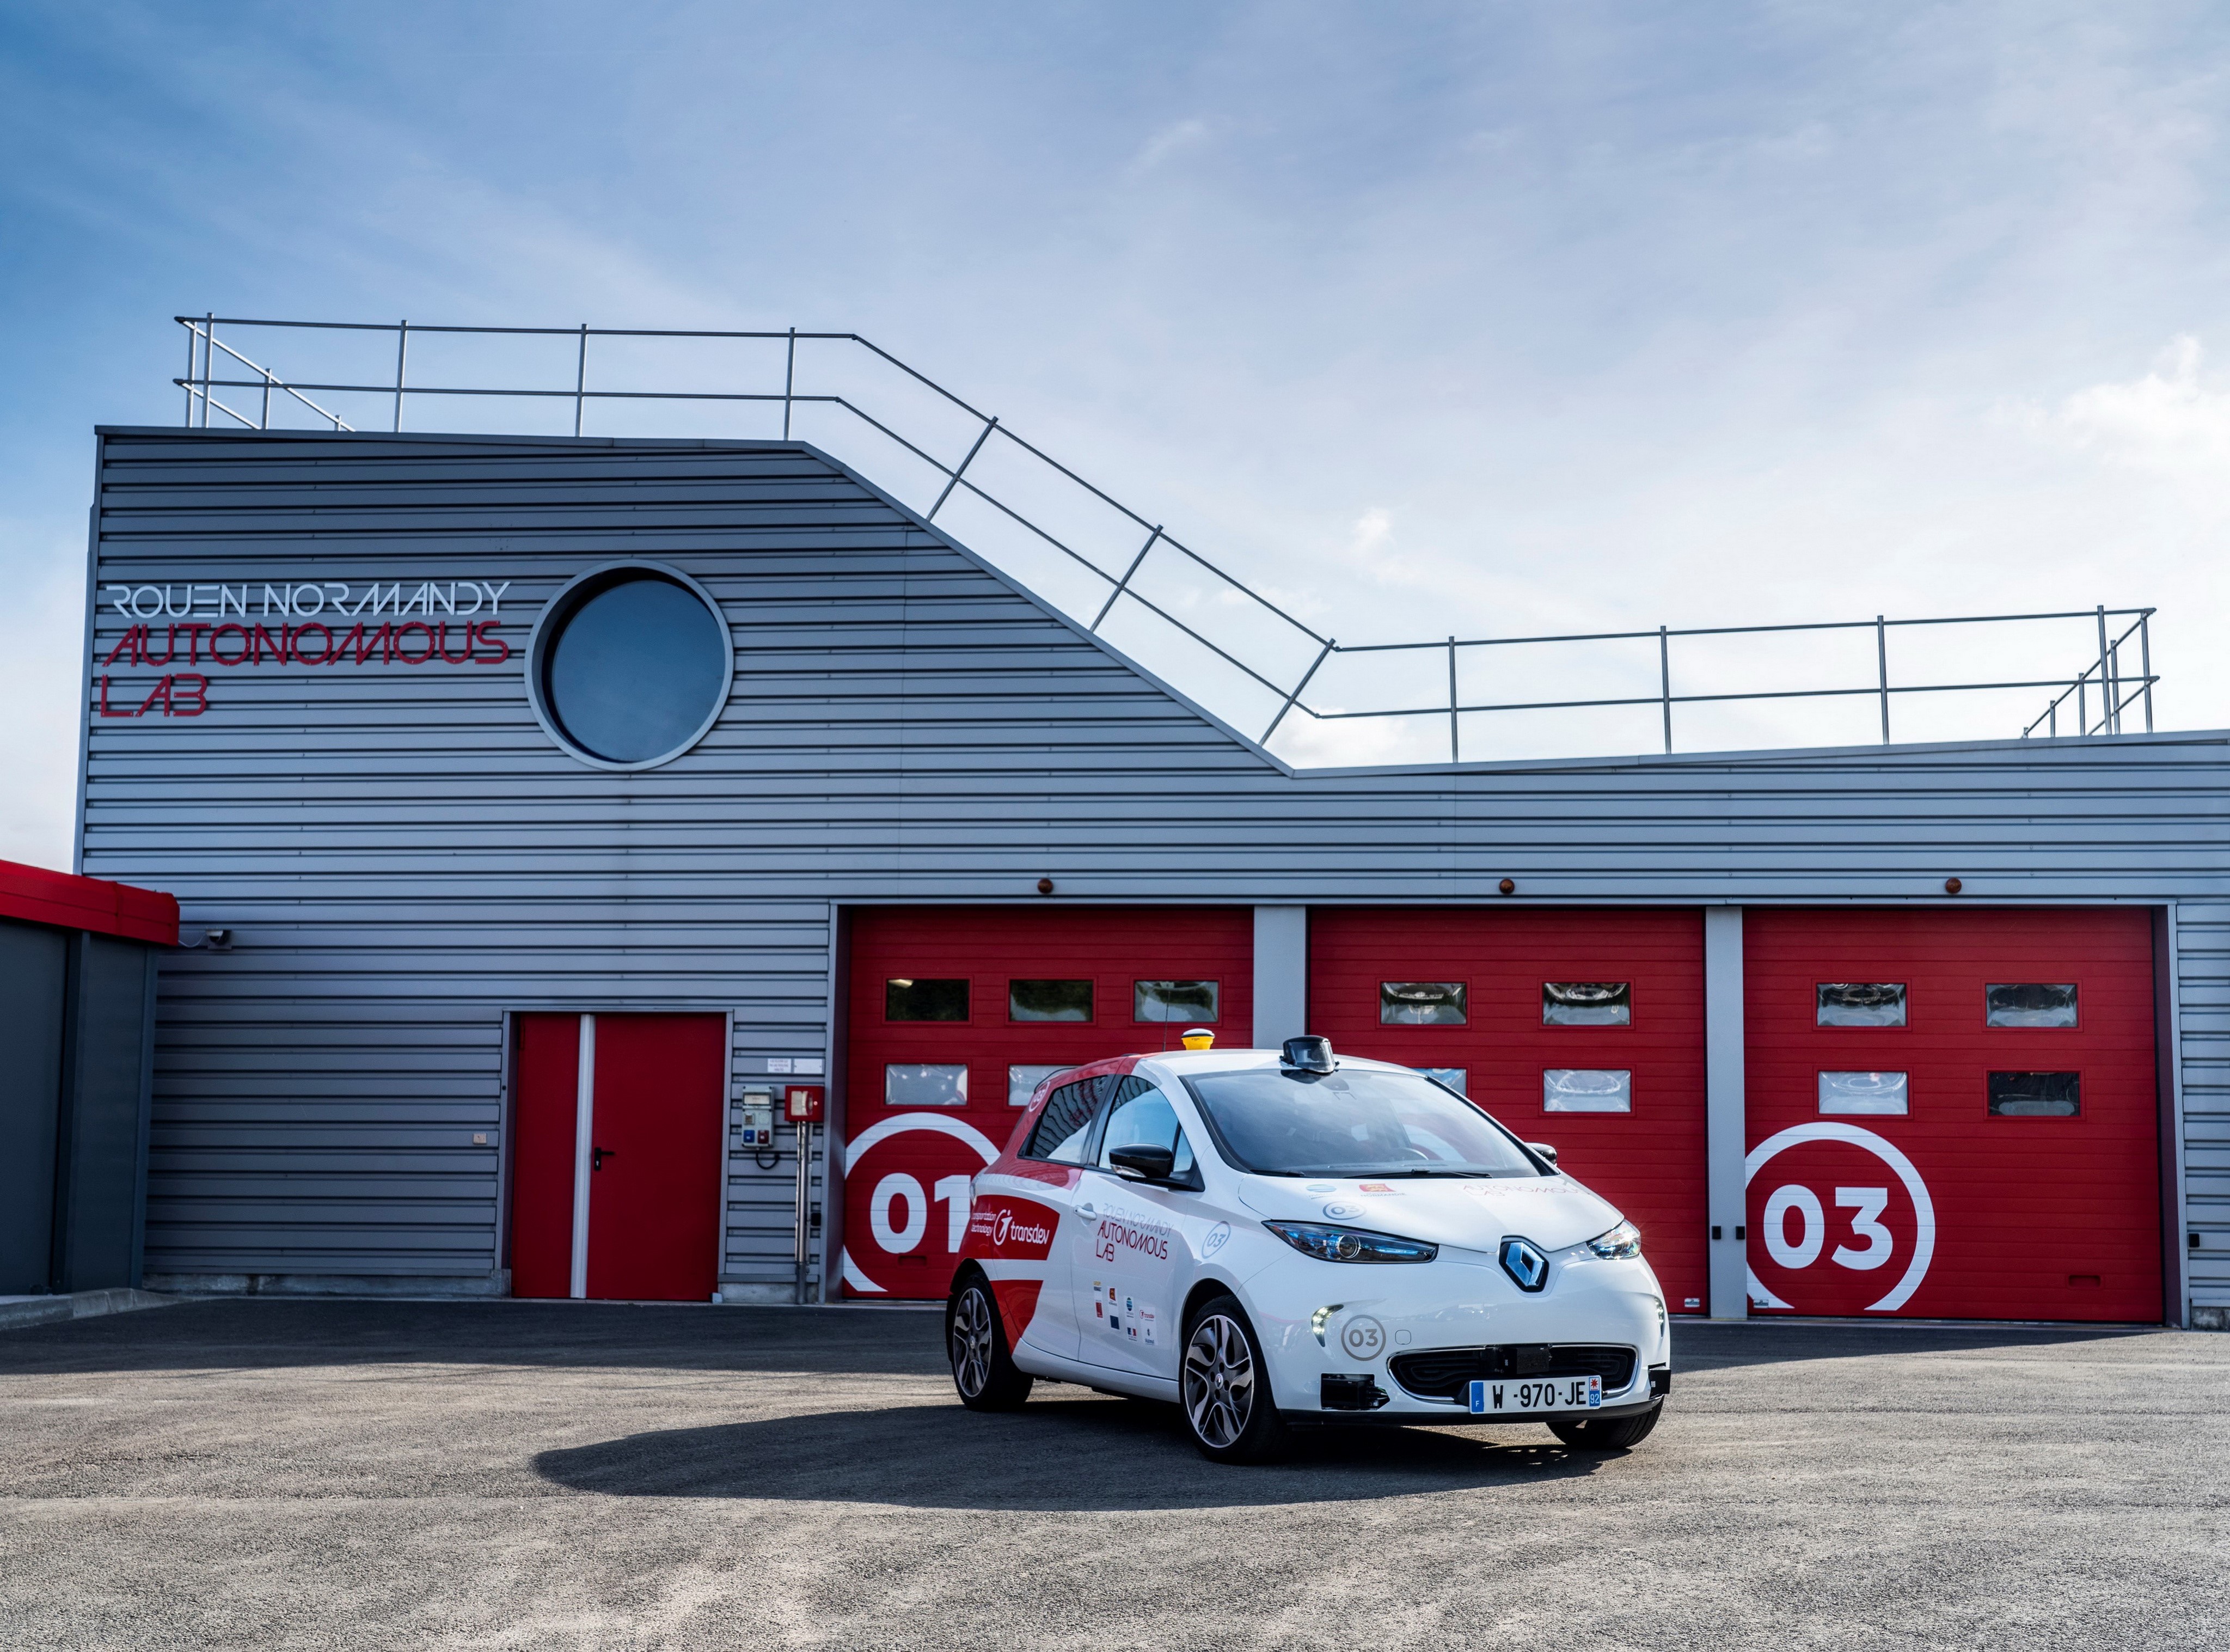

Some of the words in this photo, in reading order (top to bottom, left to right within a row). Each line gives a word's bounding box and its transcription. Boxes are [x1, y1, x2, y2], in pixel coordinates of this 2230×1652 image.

[106, 584, 247, 619] ROUEN
[264, 582, 510, 617] NORMANDY
[102, 621, 509, 667] AUTONOMOUS
[100, 673, 208, 717] LAB
[870, 1172, 971, 1254] 01
[1331, 1206, 1360, 1214] 03
[1010, 1221, 1050, 1245] transdev
[1097, 1220, 1168, 1260] AUTONOMOUS
[1206, 1233, 1227, 1247] 03
[1763, 1184, 1894, 1270] 03
[1095, 1239, 1115, 1262] LAB
[1349, 1329, 1378, 1347] 03
[1590, 1393, 1600, 1404] 92
